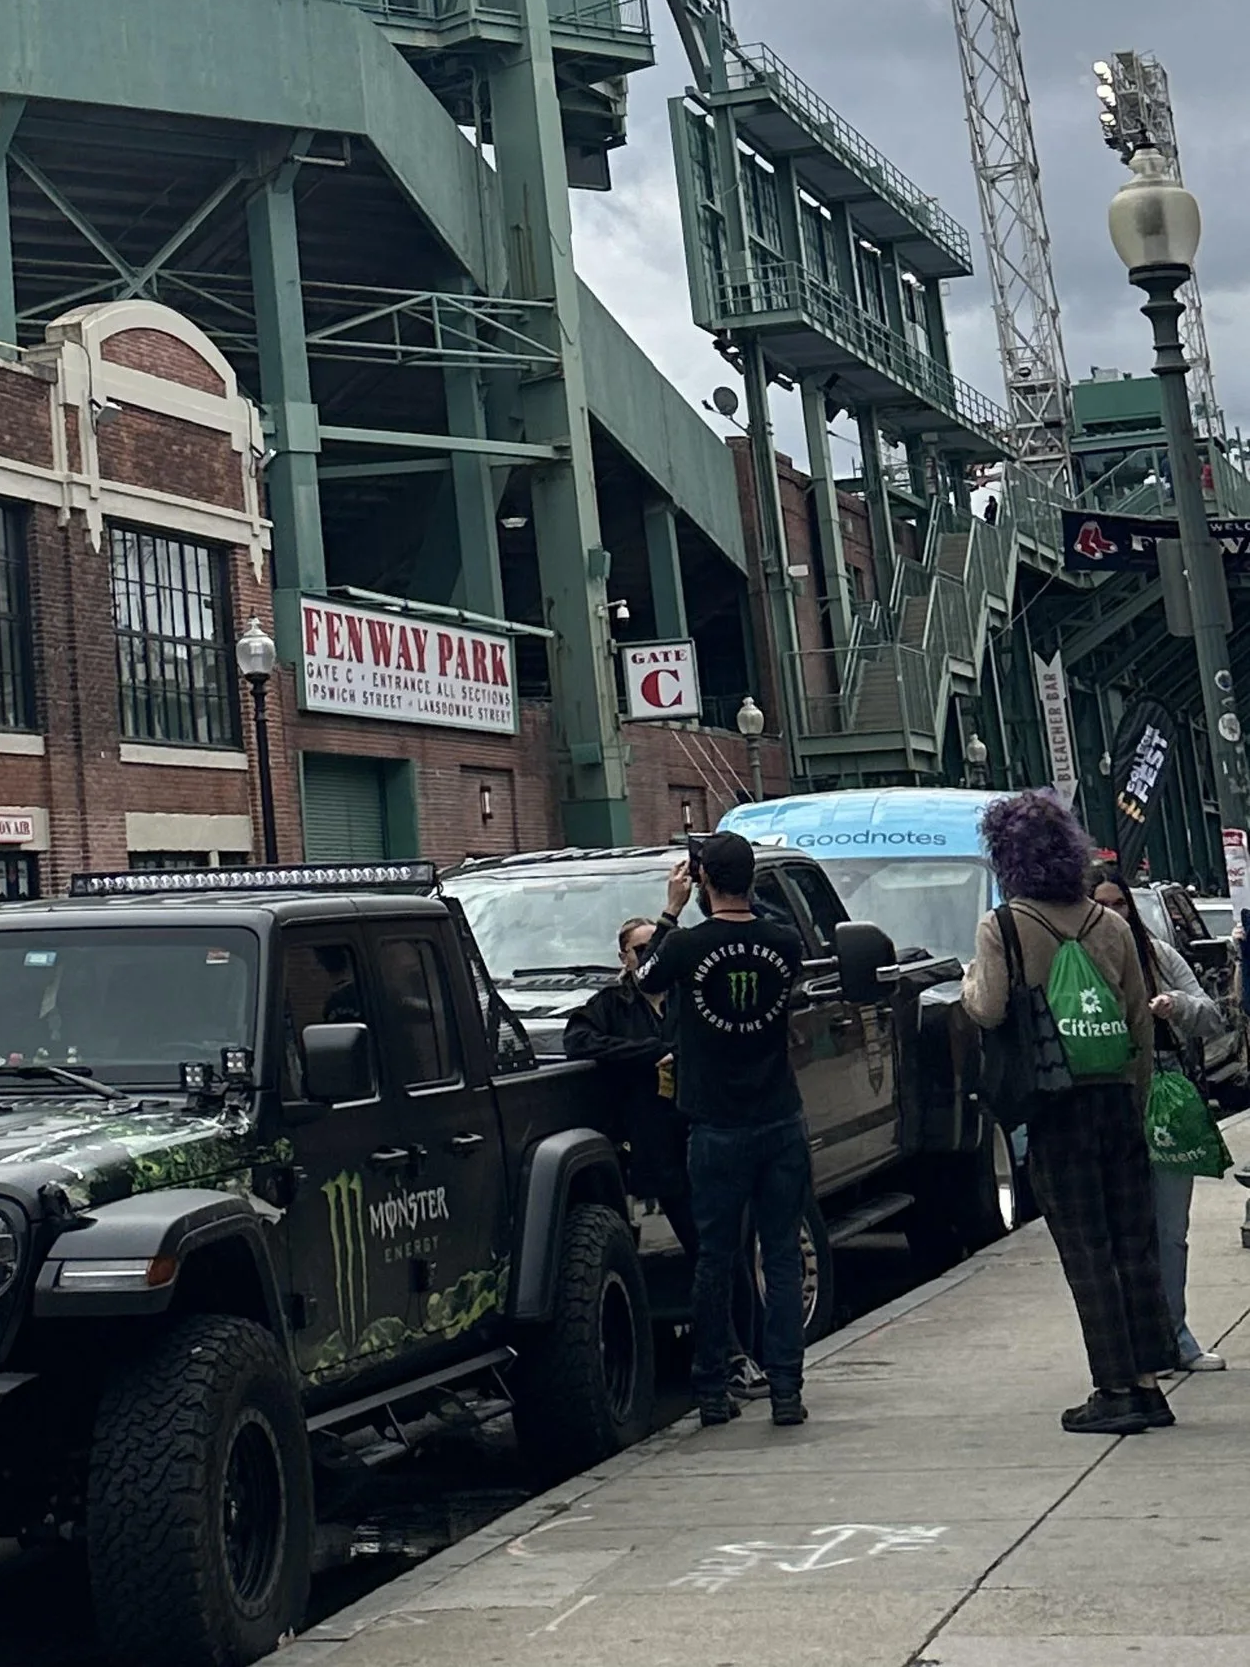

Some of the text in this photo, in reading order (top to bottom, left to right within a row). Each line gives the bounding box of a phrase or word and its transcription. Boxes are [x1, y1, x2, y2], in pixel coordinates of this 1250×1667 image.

[303, 607, 510, 688] FENWAY PARK
[631, 649, 688, 665] GATE
[306, 662, 511, 707] GATE C ENTRANCE ALL SECTIONS
[308, 683, 511, 724] IPSWICH STREET LANSDOWNE STREET
[641, 669, 683, 709] C
[1043, 673, 1059, 700] BAR
[1048, 707, 1072, 782] BLEACHER
[1134, 735, 1168, 804] FEST
[14, 821, 30, 835] AIR
[796, 829, 947, 848] Goodnotes
[693, 943, 746, 982] MONSTER
[739, 1019, 763, 1033] THE
[1058, 1018, 1128, 1038] Citizens
[369, 1186, 449, 1240] MONSTER
[384, 1235, 439, 1263] ENERGY
